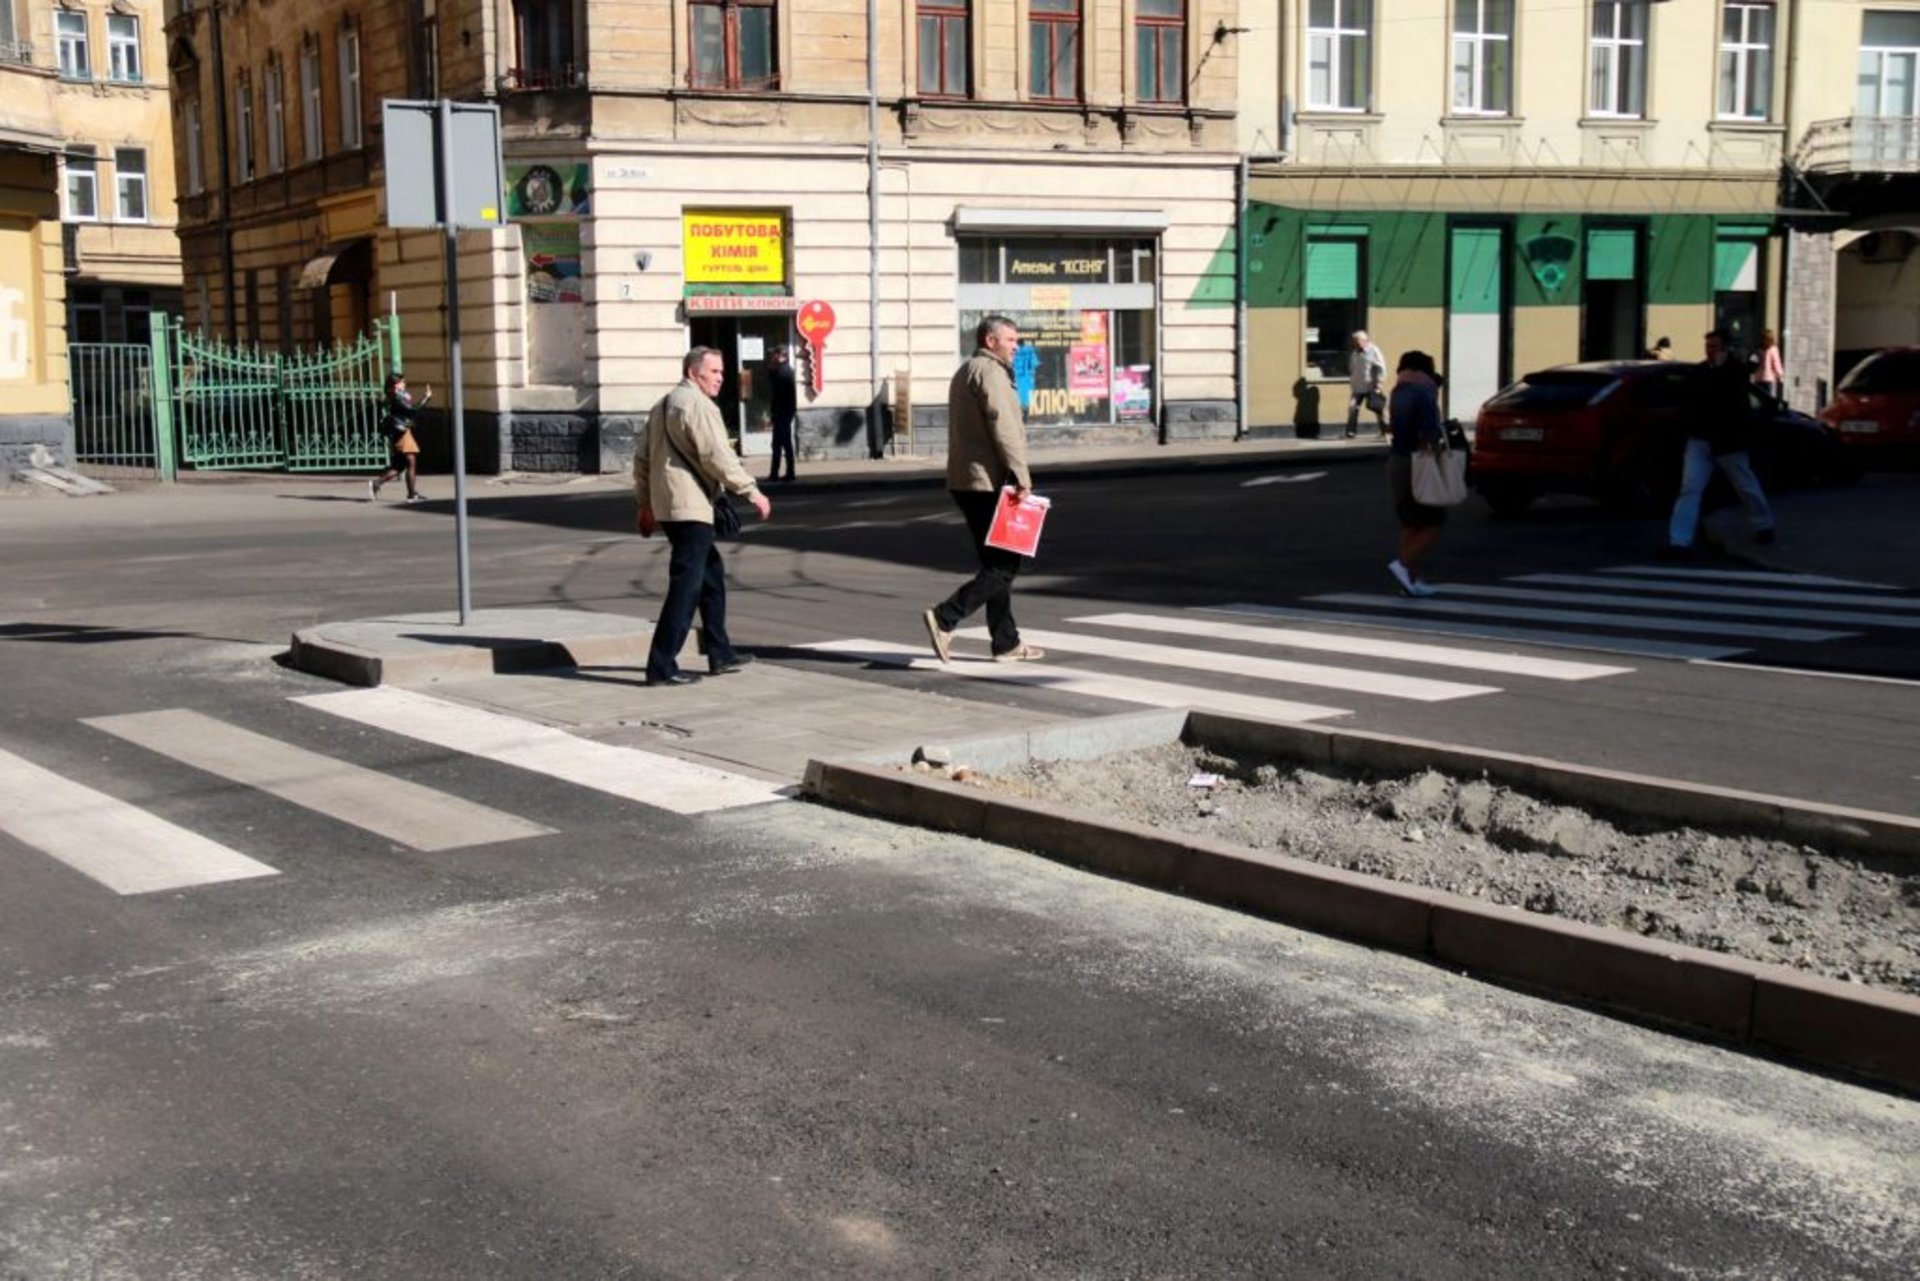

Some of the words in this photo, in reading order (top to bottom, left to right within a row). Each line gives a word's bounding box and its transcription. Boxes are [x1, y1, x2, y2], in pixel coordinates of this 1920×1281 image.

[690, 224, 782, 238] ПОБУТОВА
[711, 245, 758, 258] ХІМІЯ
[689, 298, 743, 310] КВІТИ
